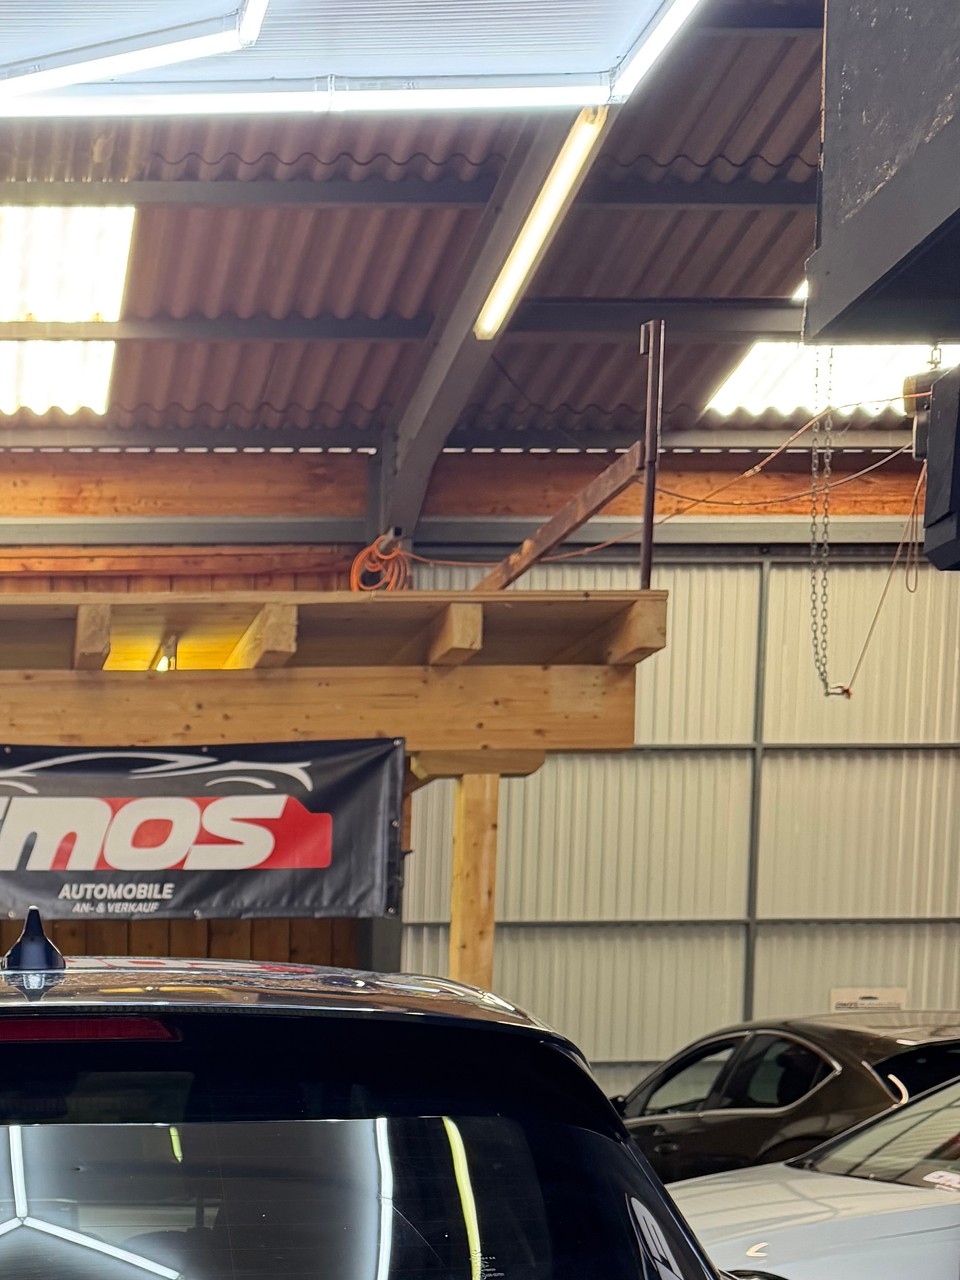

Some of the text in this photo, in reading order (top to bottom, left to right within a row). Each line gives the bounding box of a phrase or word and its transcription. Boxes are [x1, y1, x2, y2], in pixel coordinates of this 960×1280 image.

[58, 883, 174, 899] AUTOMOBILE
[72, 901, 160, 913] AN- & VERKAUF
